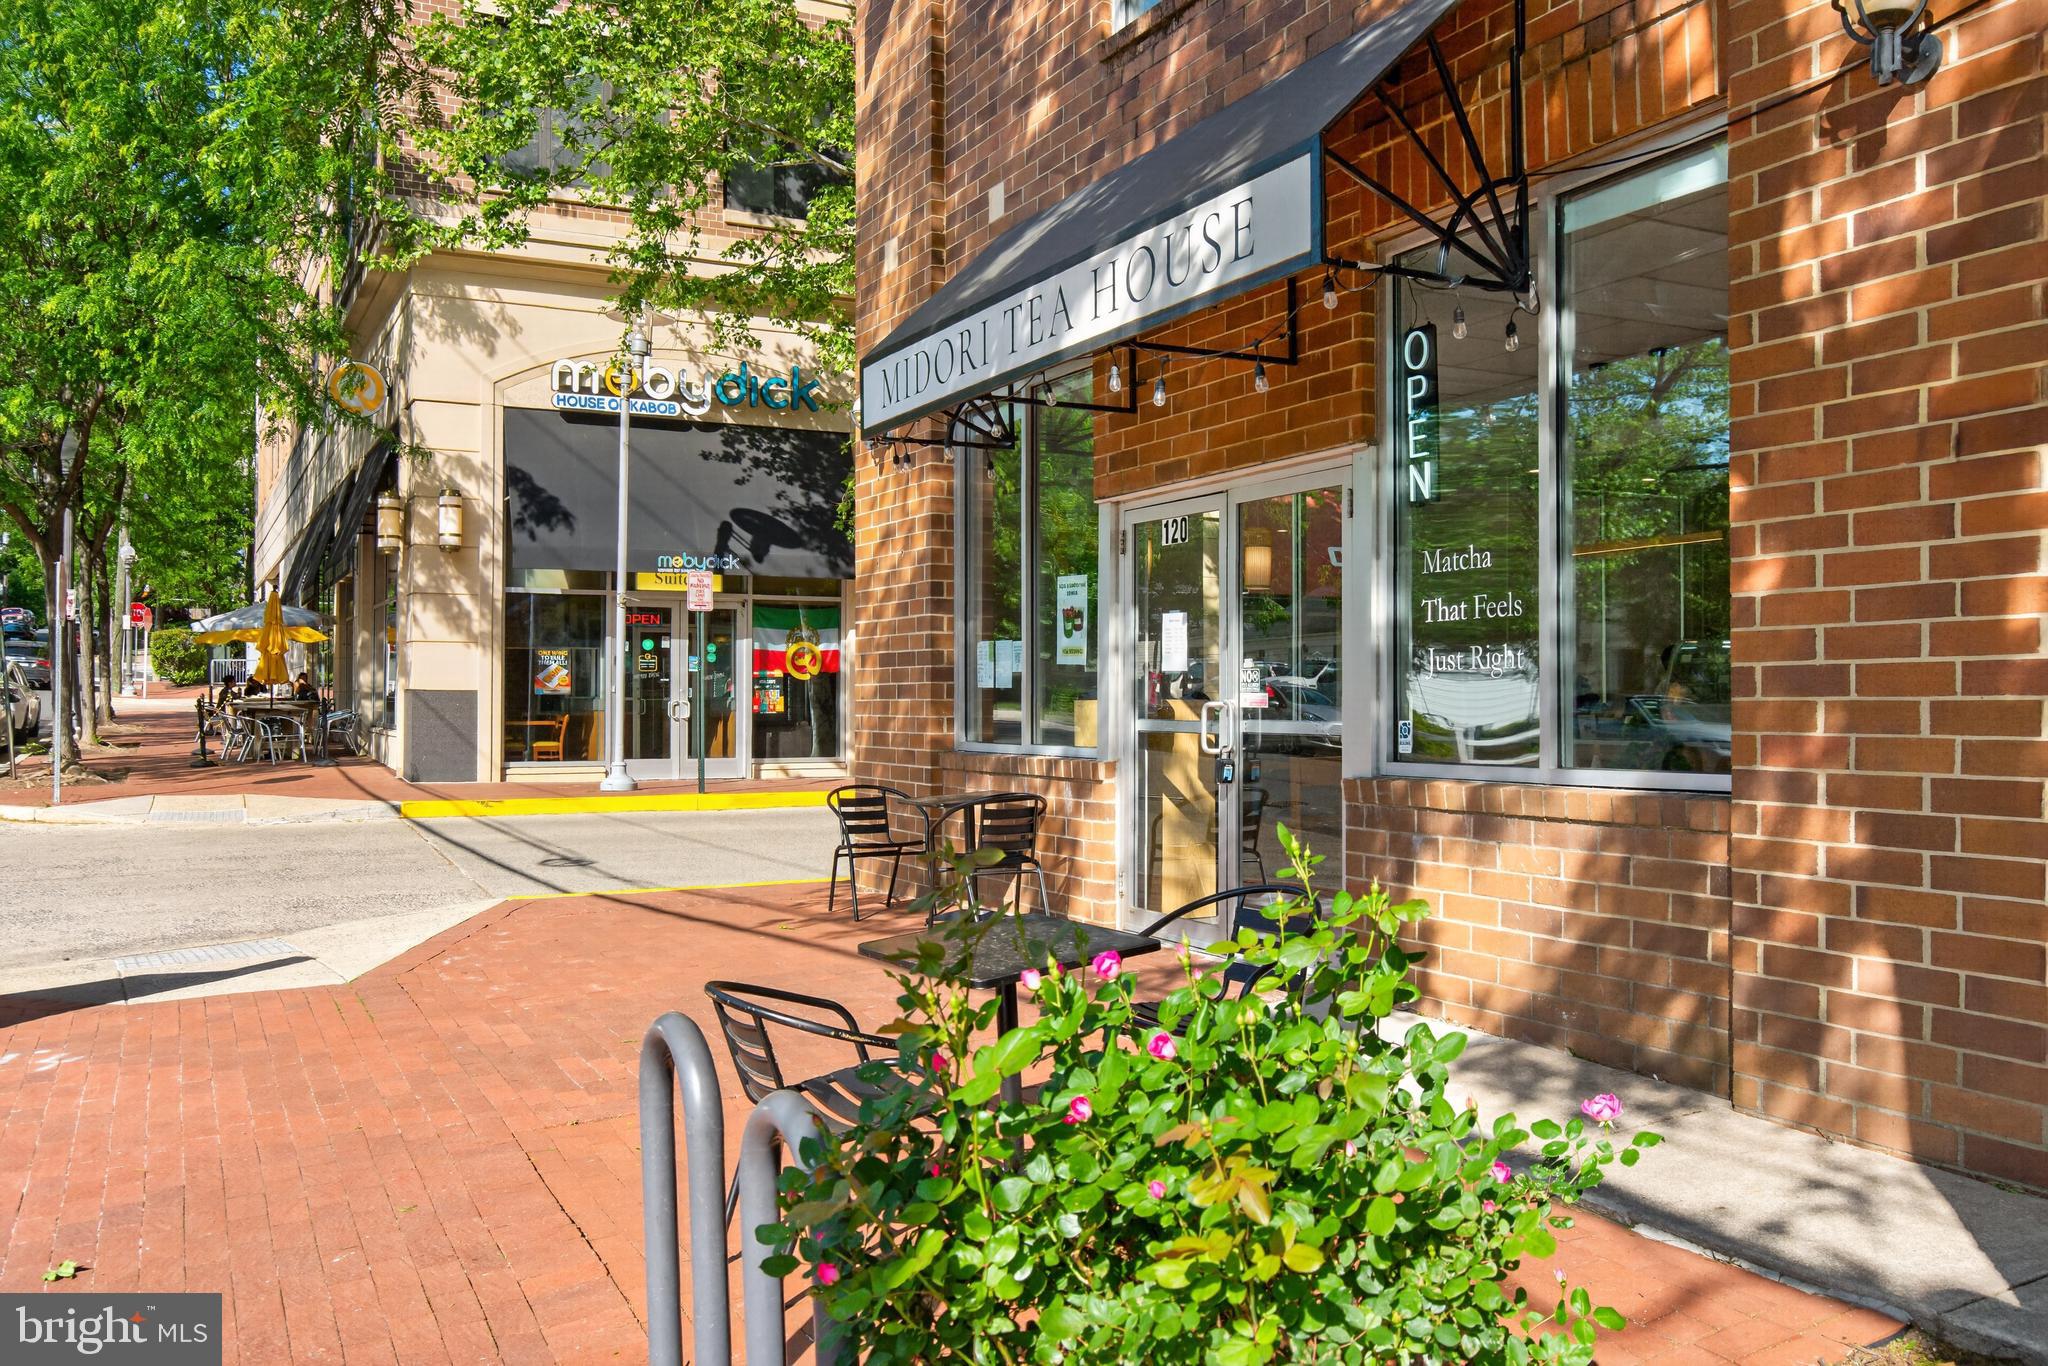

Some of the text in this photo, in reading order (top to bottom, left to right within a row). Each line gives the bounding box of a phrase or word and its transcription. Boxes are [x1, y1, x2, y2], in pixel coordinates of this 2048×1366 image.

[880, 196, 1256, 410] MIDORI TEA HOUSE
[556, 394, 677, 415] HOUSE O KABOB
[1404, 329, 1431, 503] OPEN
[1163, 516, 1188, 545] 120
[1422, 544, 1493, 575] Matcha
[1421, 592, 1523, 624] That Feels
[1426, 644, 1525, 680] Just Right
